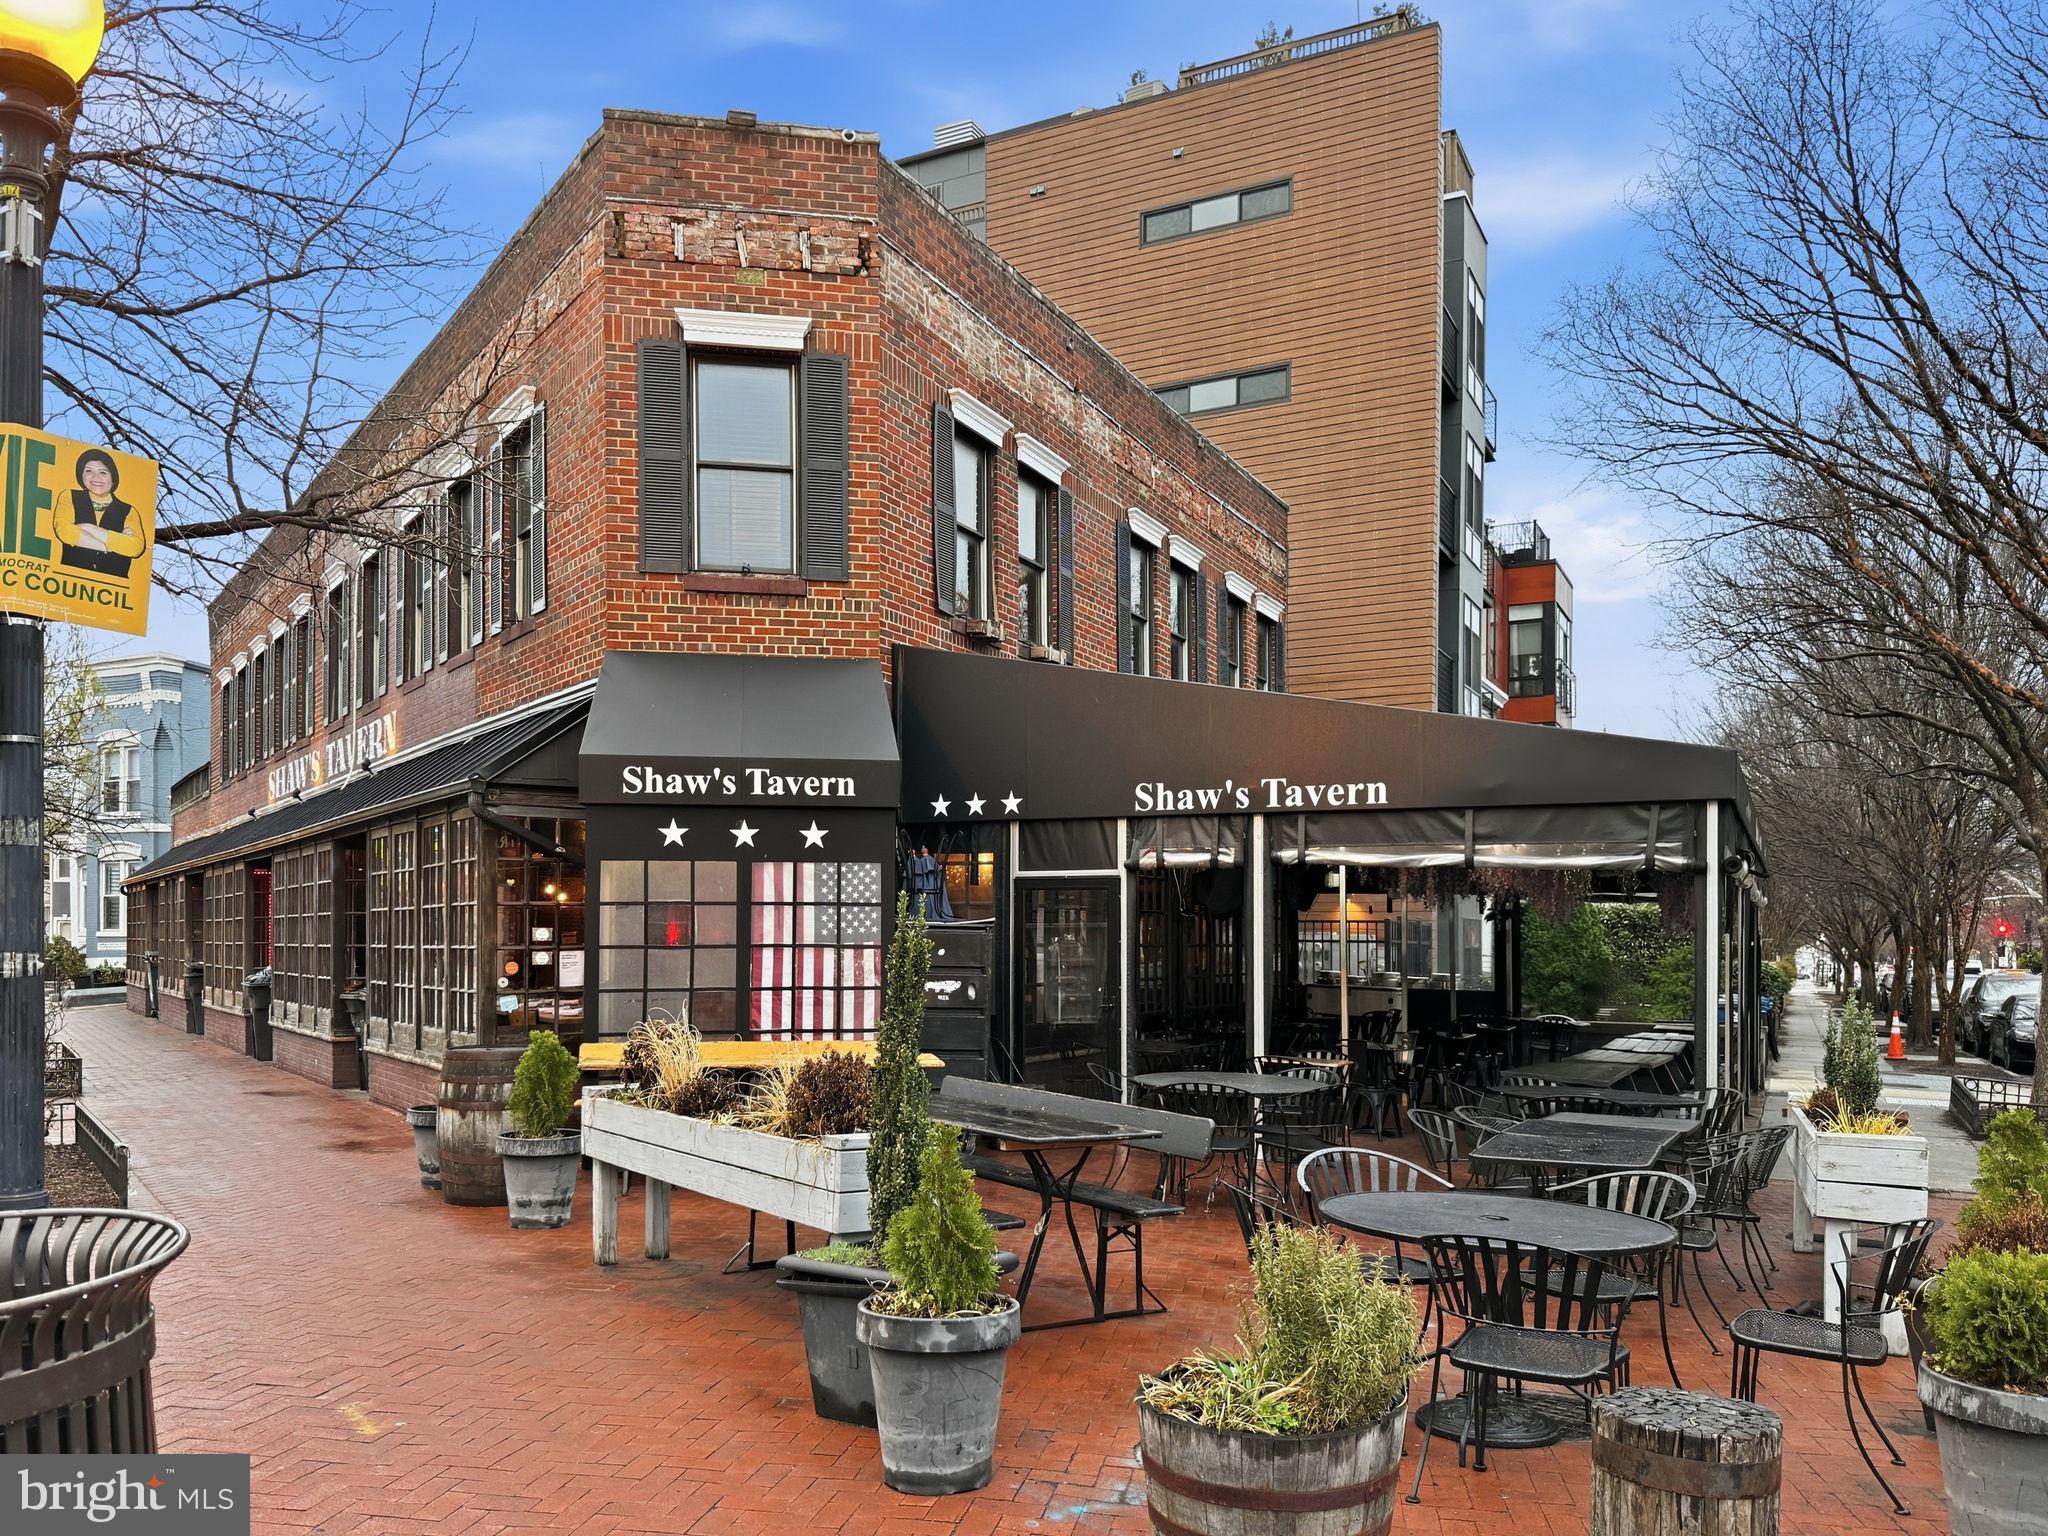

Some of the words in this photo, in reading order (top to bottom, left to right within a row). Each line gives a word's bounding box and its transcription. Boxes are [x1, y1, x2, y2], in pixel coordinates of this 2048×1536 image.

[25, 573, 134, 611] COUNCIL
[268, 750, 321, 799] SHAW'S
[325, 710, 398, 778] TAVERN
[622, 765, 737, 795] Shaw's
[745, 768, 856, 797] Tavern
[1135, 779, 1249, 812] Shaw's
[1260, 777, 1389, 808] Tavern
